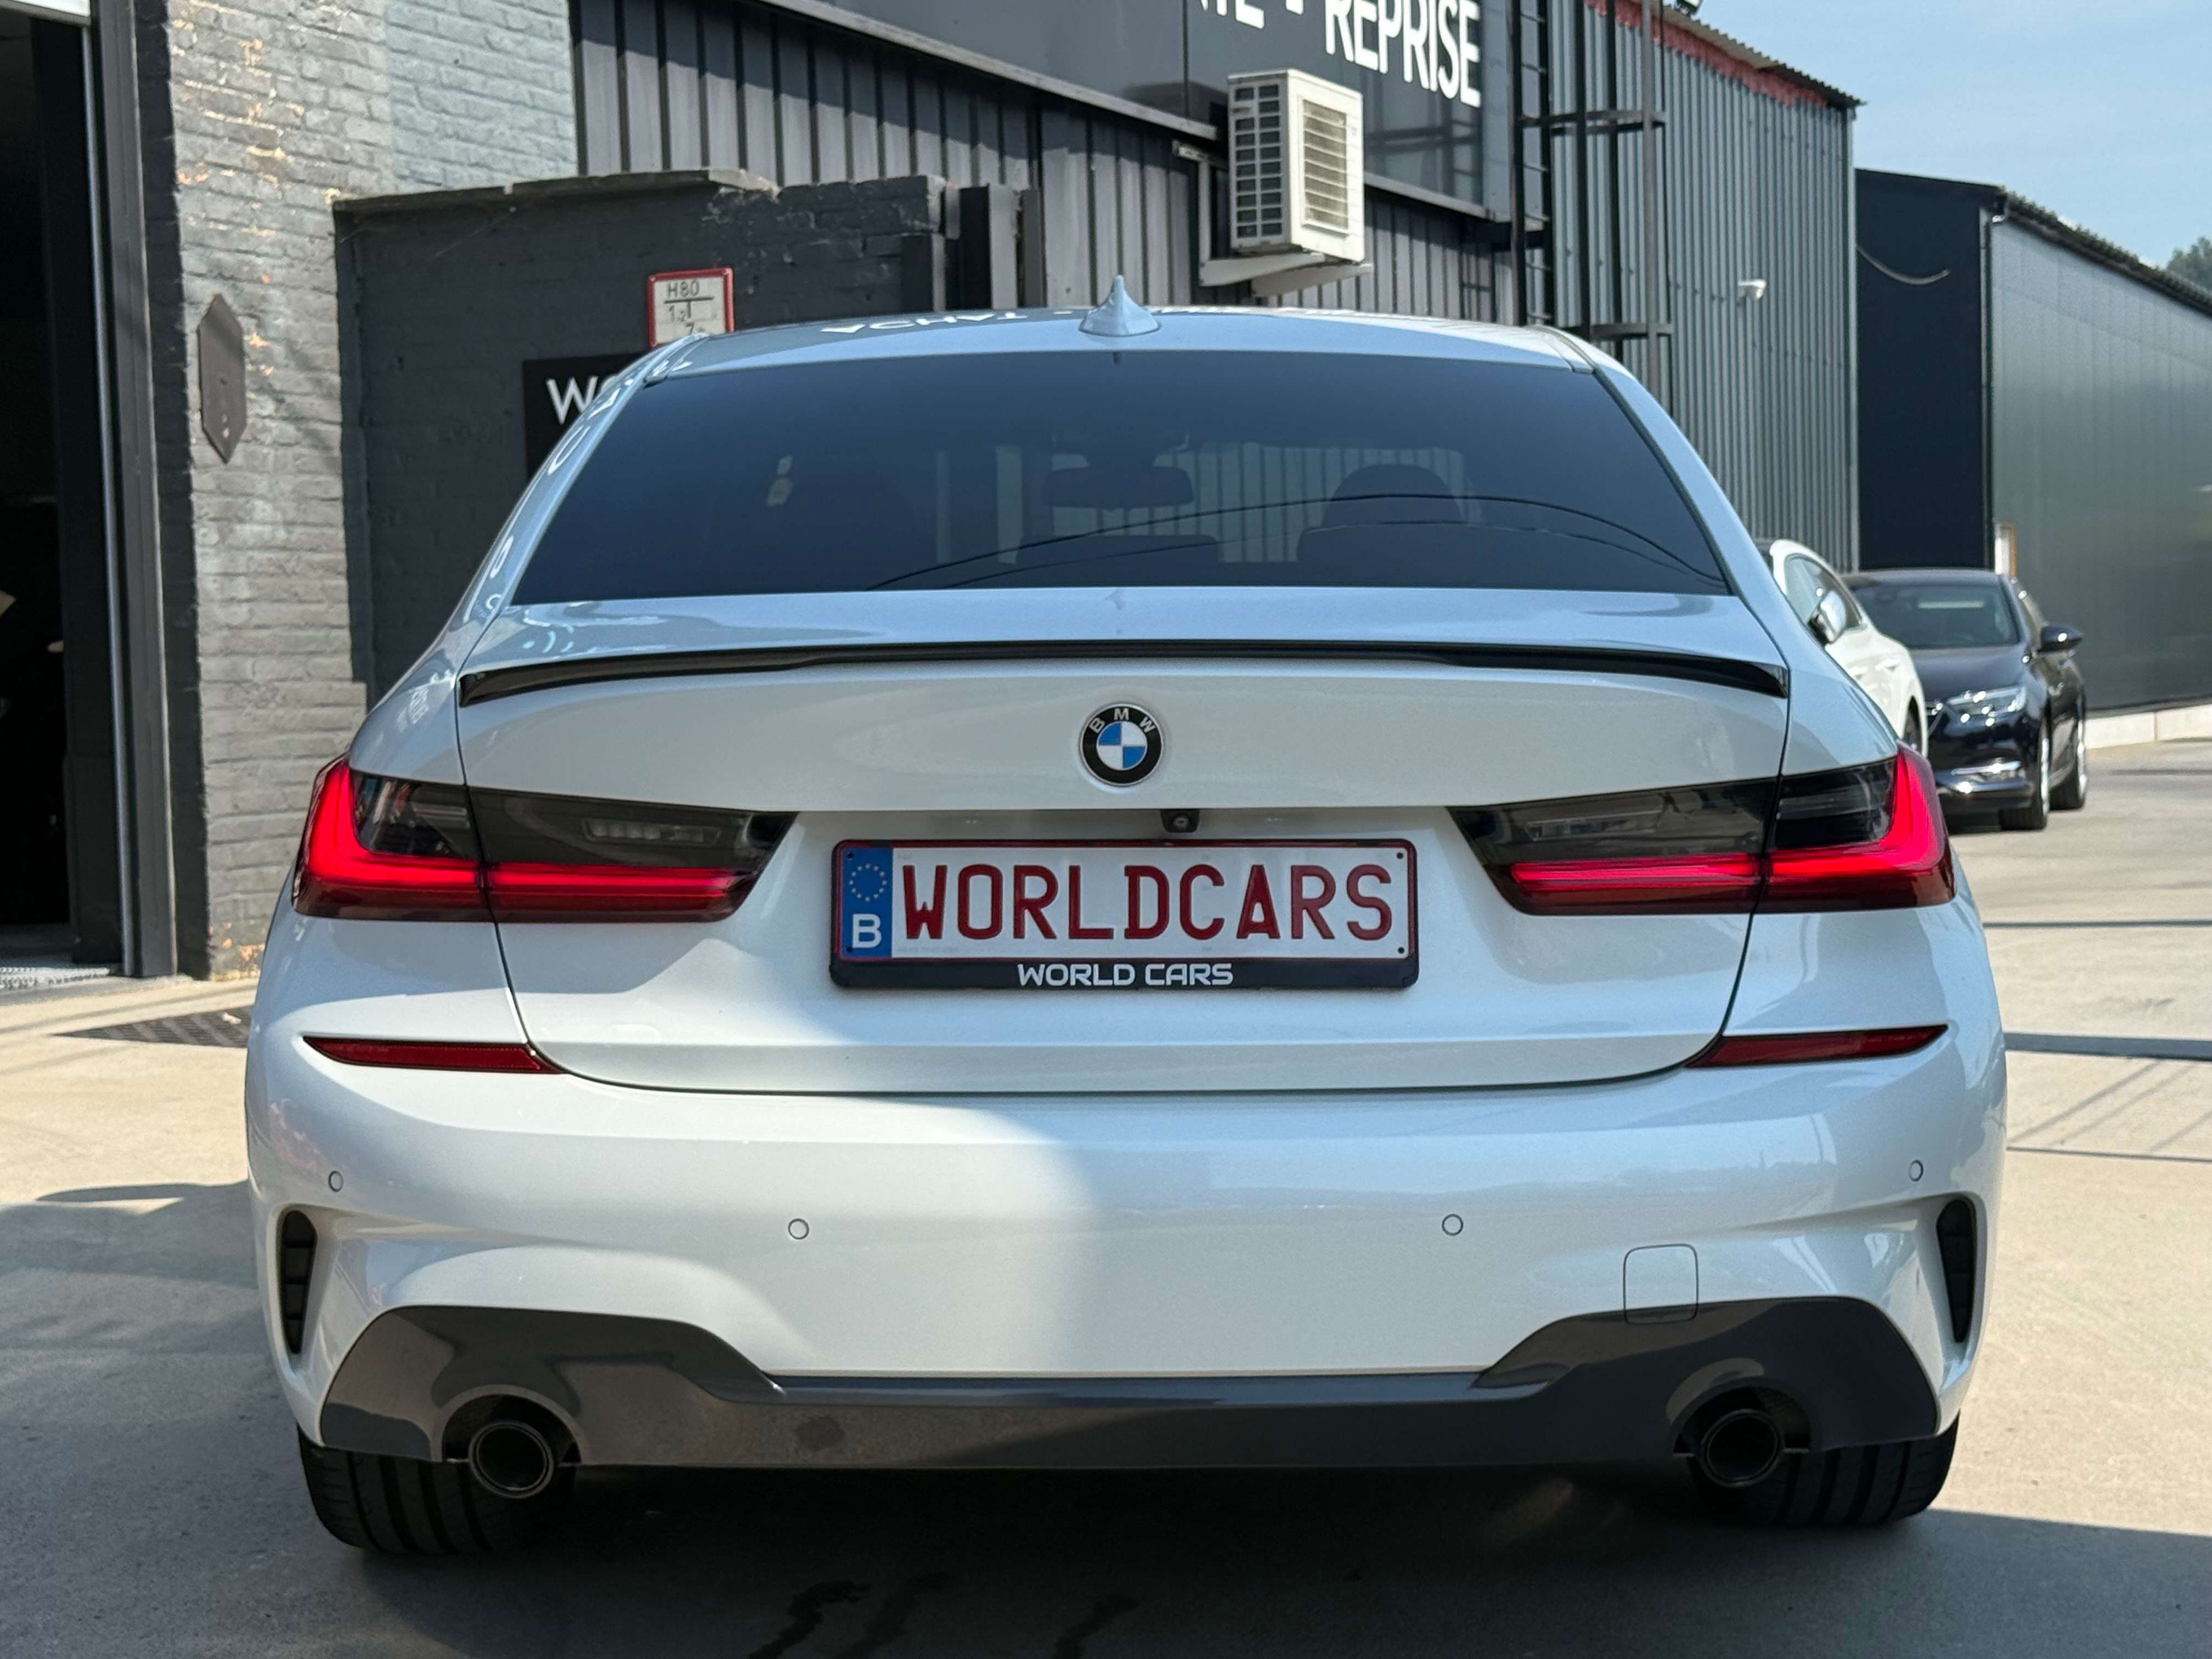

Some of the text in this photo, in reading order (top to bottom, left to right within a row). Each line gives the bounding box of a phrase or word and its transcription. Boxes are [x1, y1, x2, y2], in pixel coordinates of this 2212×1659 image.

[1325, 0, 1481, 108] REPRISE
[1088, 708, 1156, 733] BMW
[902, 864, 1392, 941] WORLDCARS
[853, 913, 882, 949] B
[1017, 963, 1234, 986] WORLD CARS
